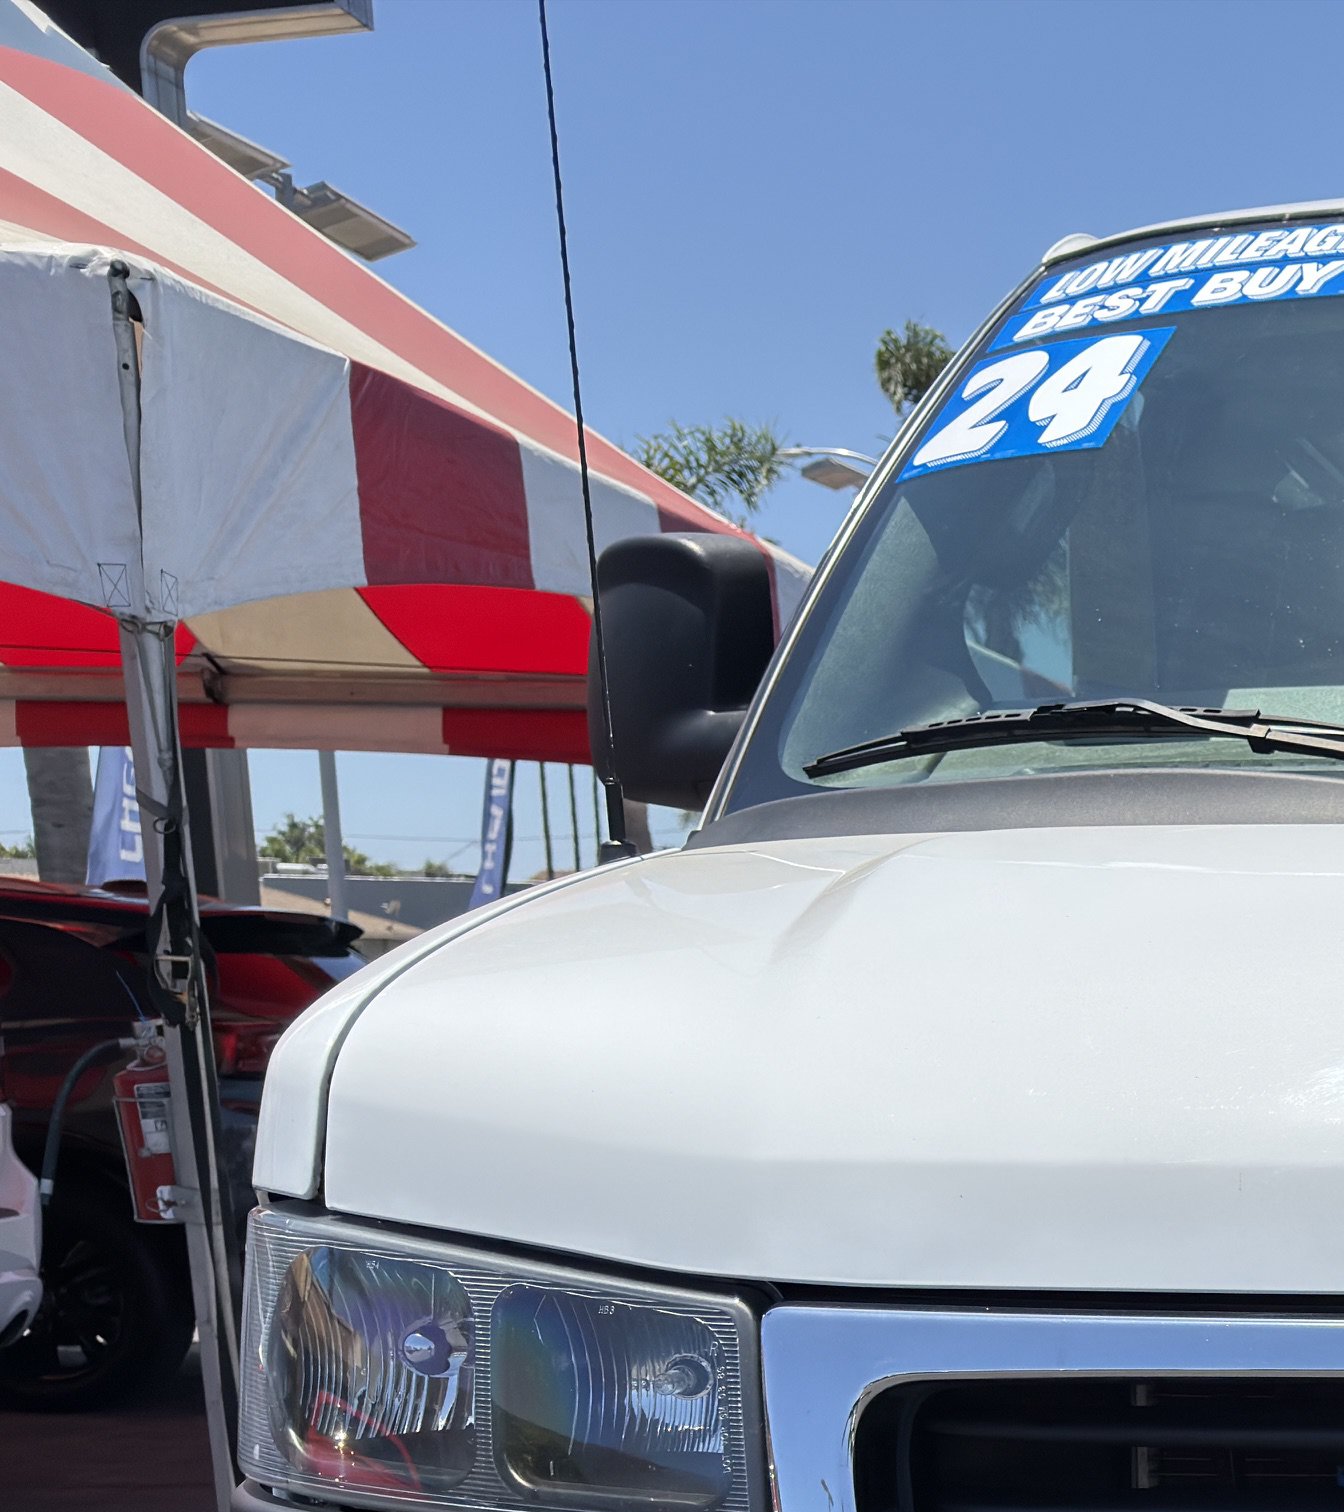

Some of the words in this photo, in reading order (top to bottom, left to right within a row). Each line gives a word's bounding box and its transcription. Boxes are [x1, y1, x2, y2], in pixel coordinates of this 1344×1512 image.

[1040, 247, 1163, 304] LOW
[1013, 276, 1195, 342] BEST
[913, 335, 1150, 467] 24
